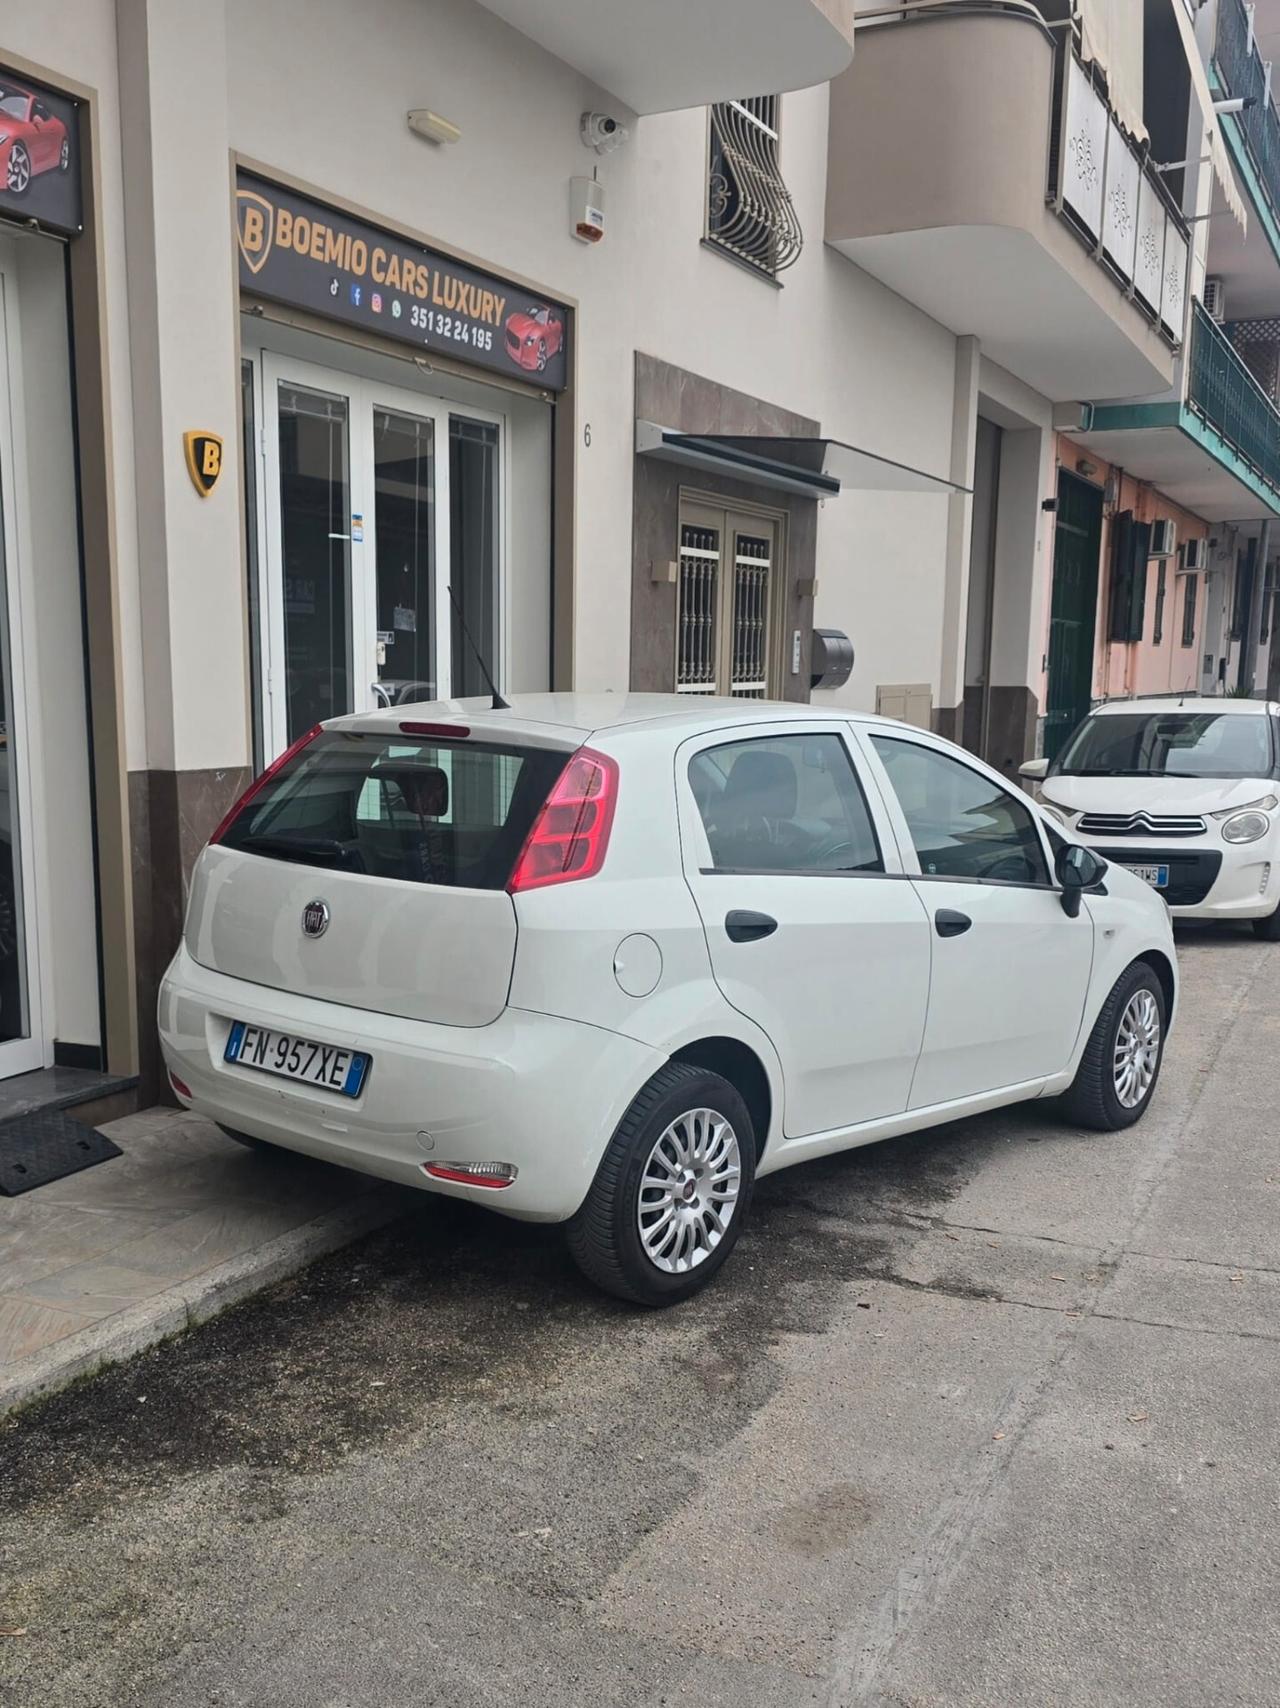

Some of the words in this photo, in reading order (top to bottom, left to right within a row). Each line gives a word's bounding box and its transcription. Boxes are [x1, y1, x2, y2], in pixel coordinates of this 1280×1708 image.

[243, 207, 264, 252] B
[275, 208, 368, 276] BOEMIO
[371, 247, 429, 299] CARS
[432, 271, 506, 327] LUXURY
[410, 304, 434, 332] 351
[435, 313, 452, 338] 32
[453, 320, 470, 344] 24
[471, 326, 493, 351] 195
[584, 423, 592, 448] 6
[203, 441, 220, 476] B
